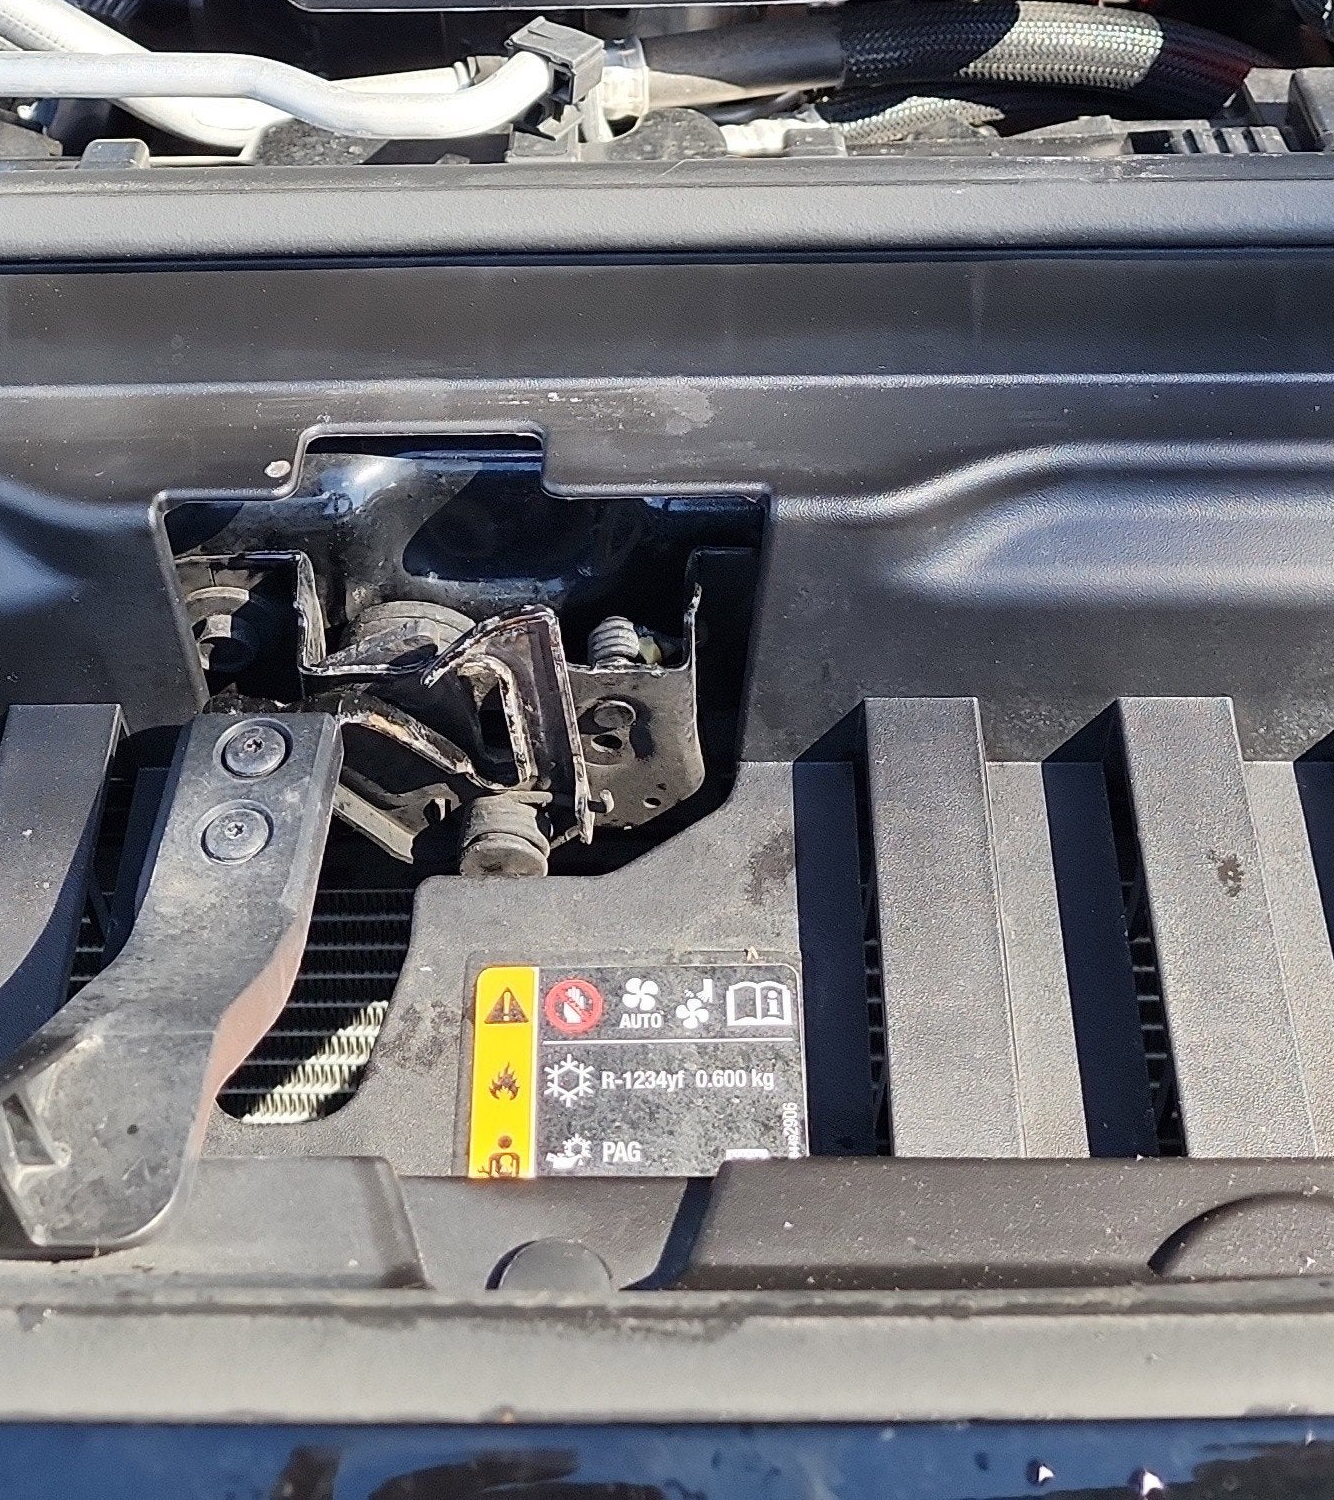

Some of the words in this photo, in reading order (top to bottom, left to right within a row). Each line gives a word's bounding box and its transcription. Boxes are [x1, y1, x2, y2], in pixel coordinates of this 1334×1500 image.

[619, 1013, 662, 1029] AUTO
[601, 1070, 685, 1093] R-1234yf
[695, 1070, 747, 1089] 0.600
[751, 1069, 775, 1091] kg
[601, 1140, 642, 1163] PAG
